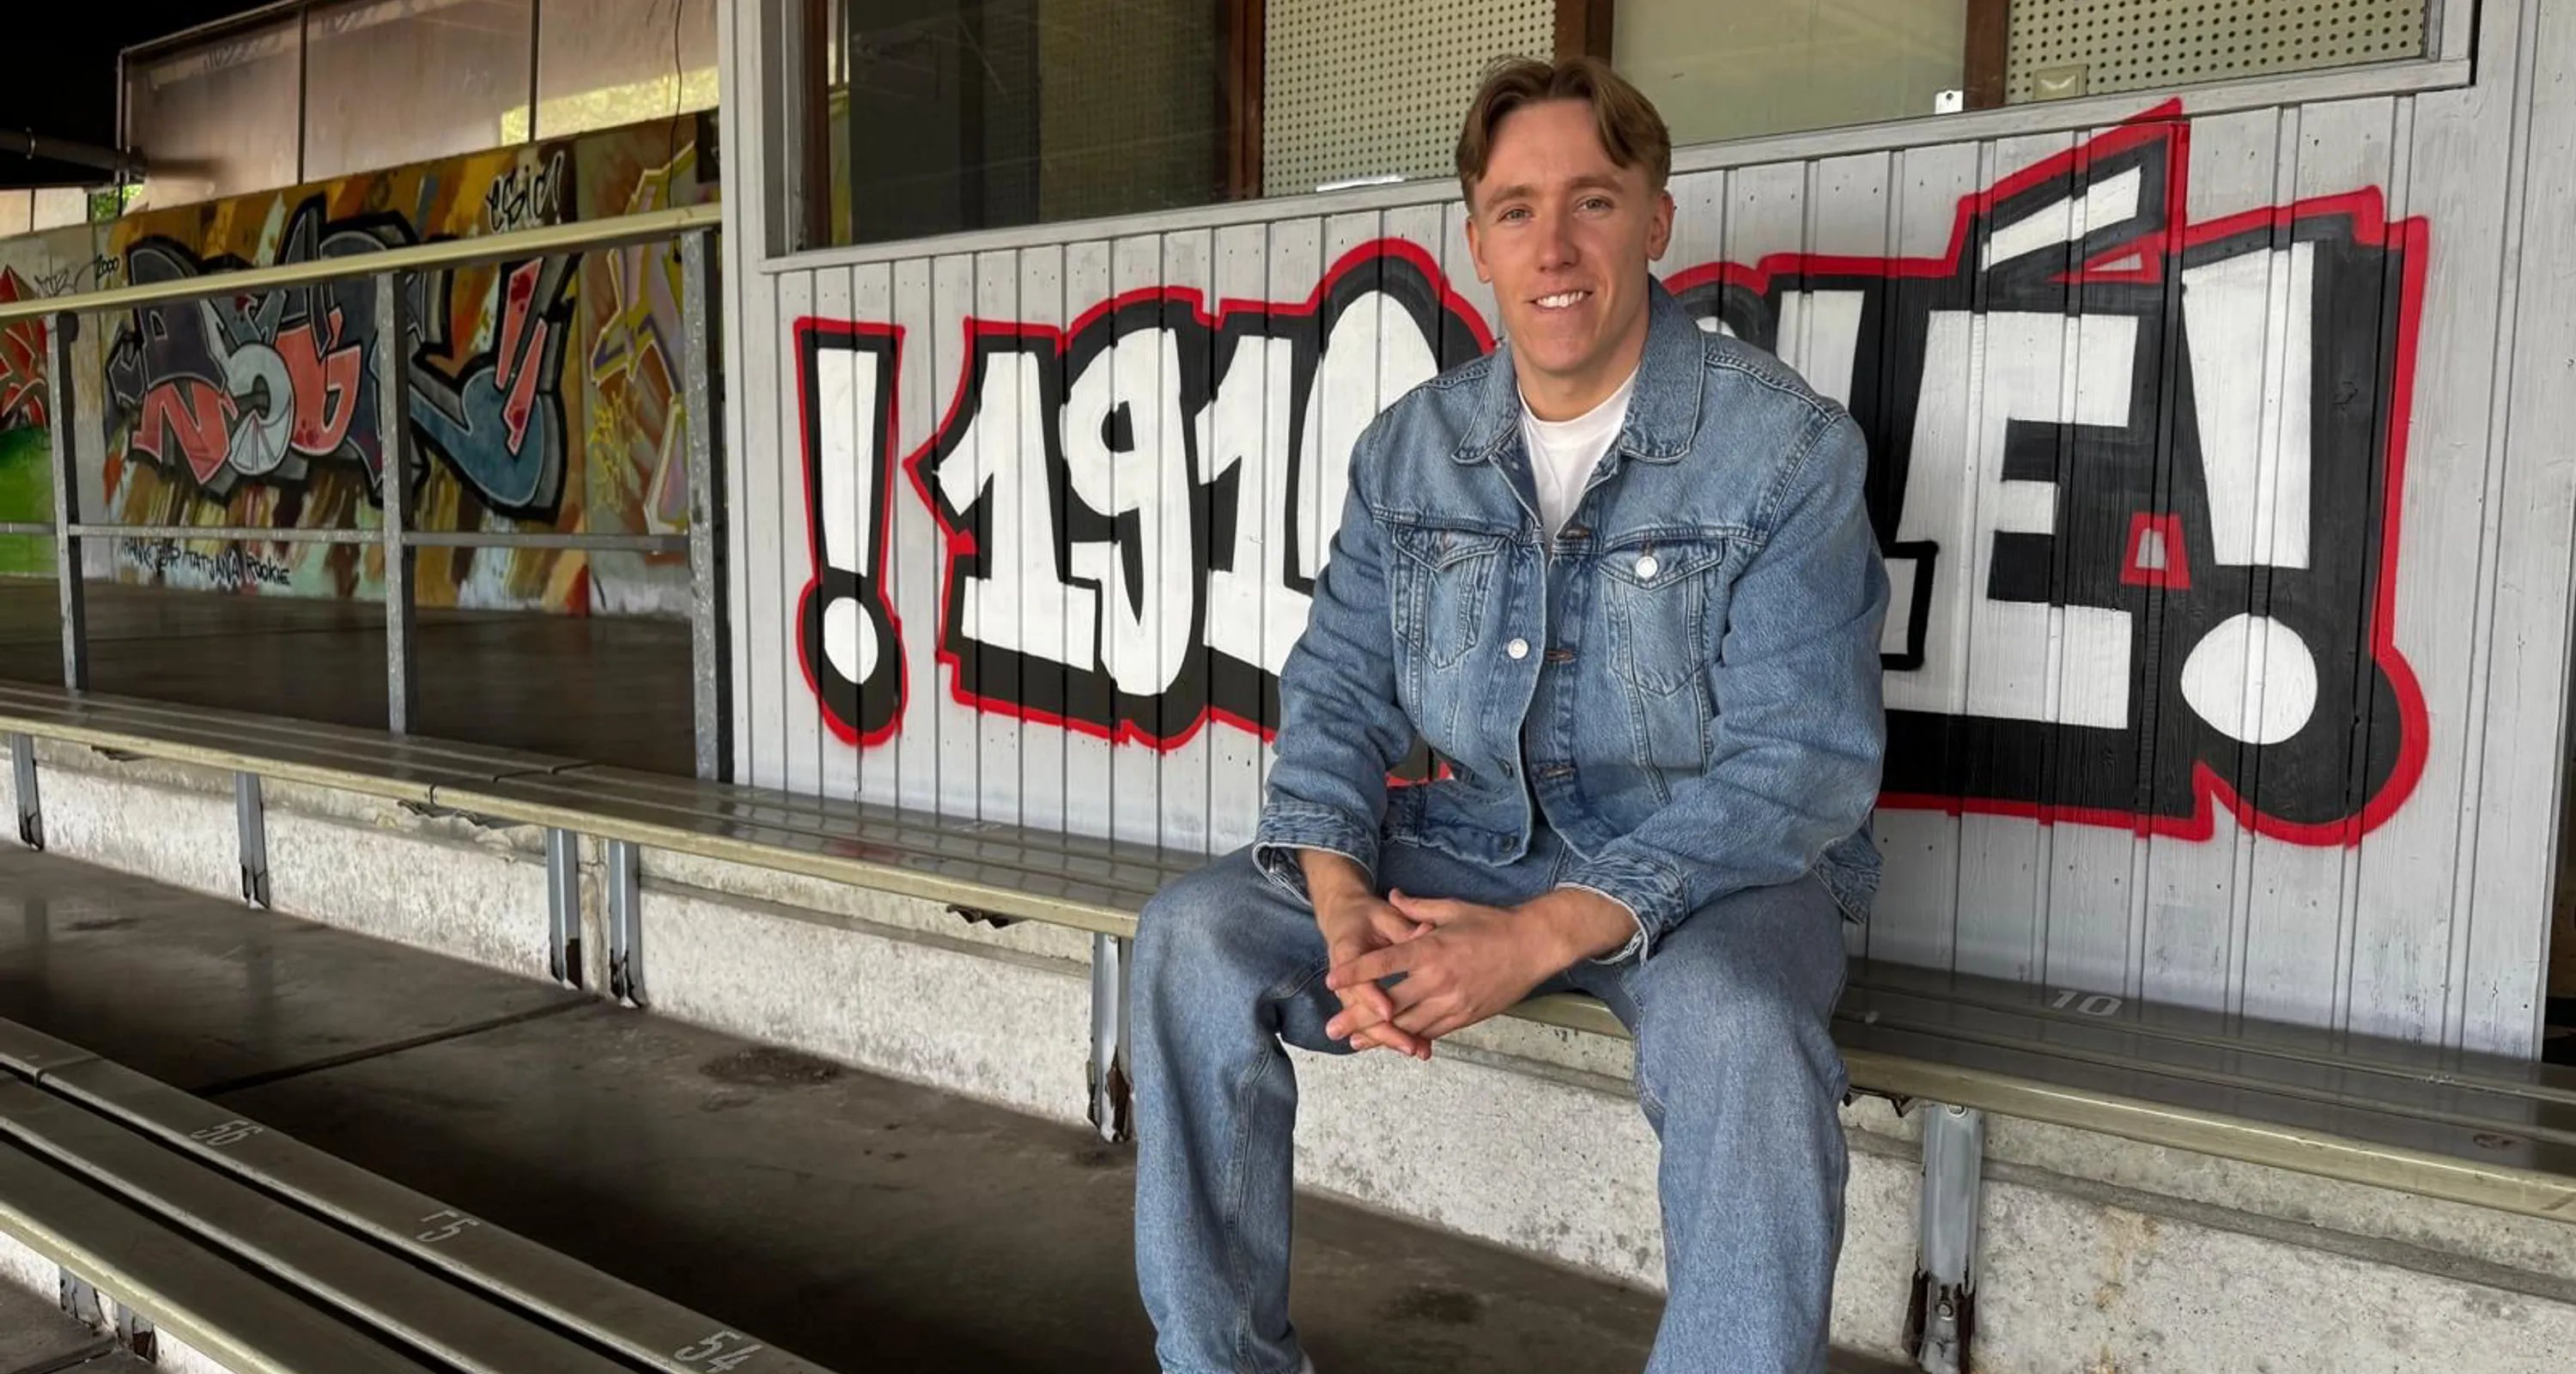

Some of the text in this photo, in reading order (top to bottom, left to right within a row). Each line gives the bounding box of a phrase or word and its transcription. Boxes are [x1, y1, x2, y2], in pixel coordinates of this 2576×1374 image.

[2050, 989, 2123, 1016] 10
[191, 1120, 264, 1146] 56
[673, 1330, 762, 1373] 54
